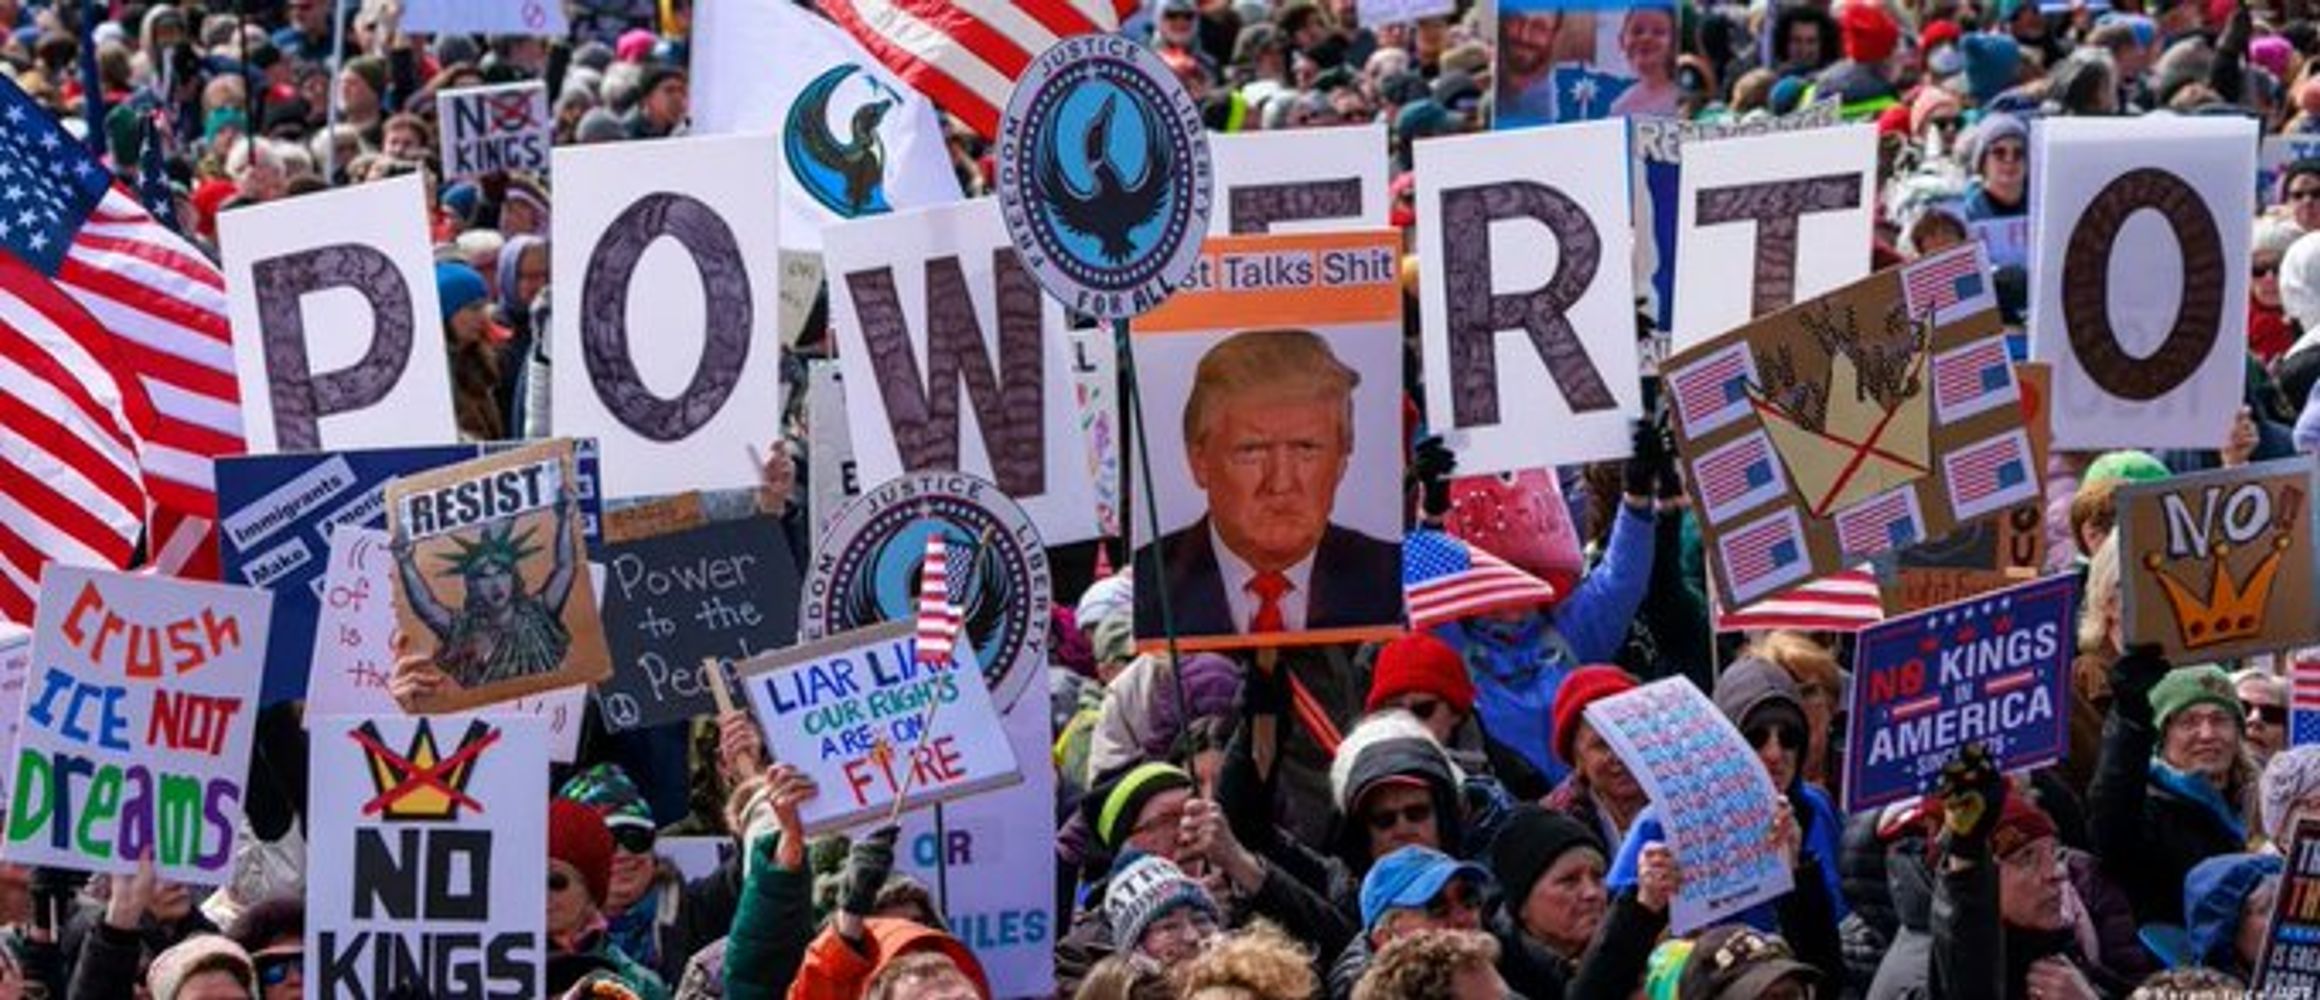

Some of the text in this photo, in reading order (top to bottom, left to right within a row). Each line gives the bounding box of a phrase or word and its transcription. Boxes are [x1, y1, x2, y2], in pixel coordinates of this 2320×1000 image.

[1042, 38, 1140, 76] JUSTICE
[1003, 117, 1044, 268] FREEDOM
[1077, 274, 1176, 315] FOR ALL
[1225, 256, 1314, 289] Talks
[1323, 249, 1393, 286] Shit
[233, 475, 342, 544] Immigrants
[410, 463, 543, 536] RESIST
[867, 477, 984, 515] JUSTICE
[250, 549, 305, 583] Make
[613, 551, 755, 600] Power
[807, 554, 837, 639] EDOM
[1016, 525, 1046, 652] LIBERTY
[637, 596, 764, 638] to the
[765, 658, 860, 715] LIAR
[1940, 622, 2058, 685] KINGS
[27, 667, 130, 751] ICE
[147, 689, 243, 756] NOT
[803, 673, 959, 736] OUR RIGHTS
[820, 714, 925, 761] ARE ON
[1867, 685, 2053, 767] AMERICA
[843, 736, 966, 806] FIRE
[8, 747, 240, 871] Dreams
[353, 828, 493, 922] NO
[318, 931, 536, 1000] KINGS
